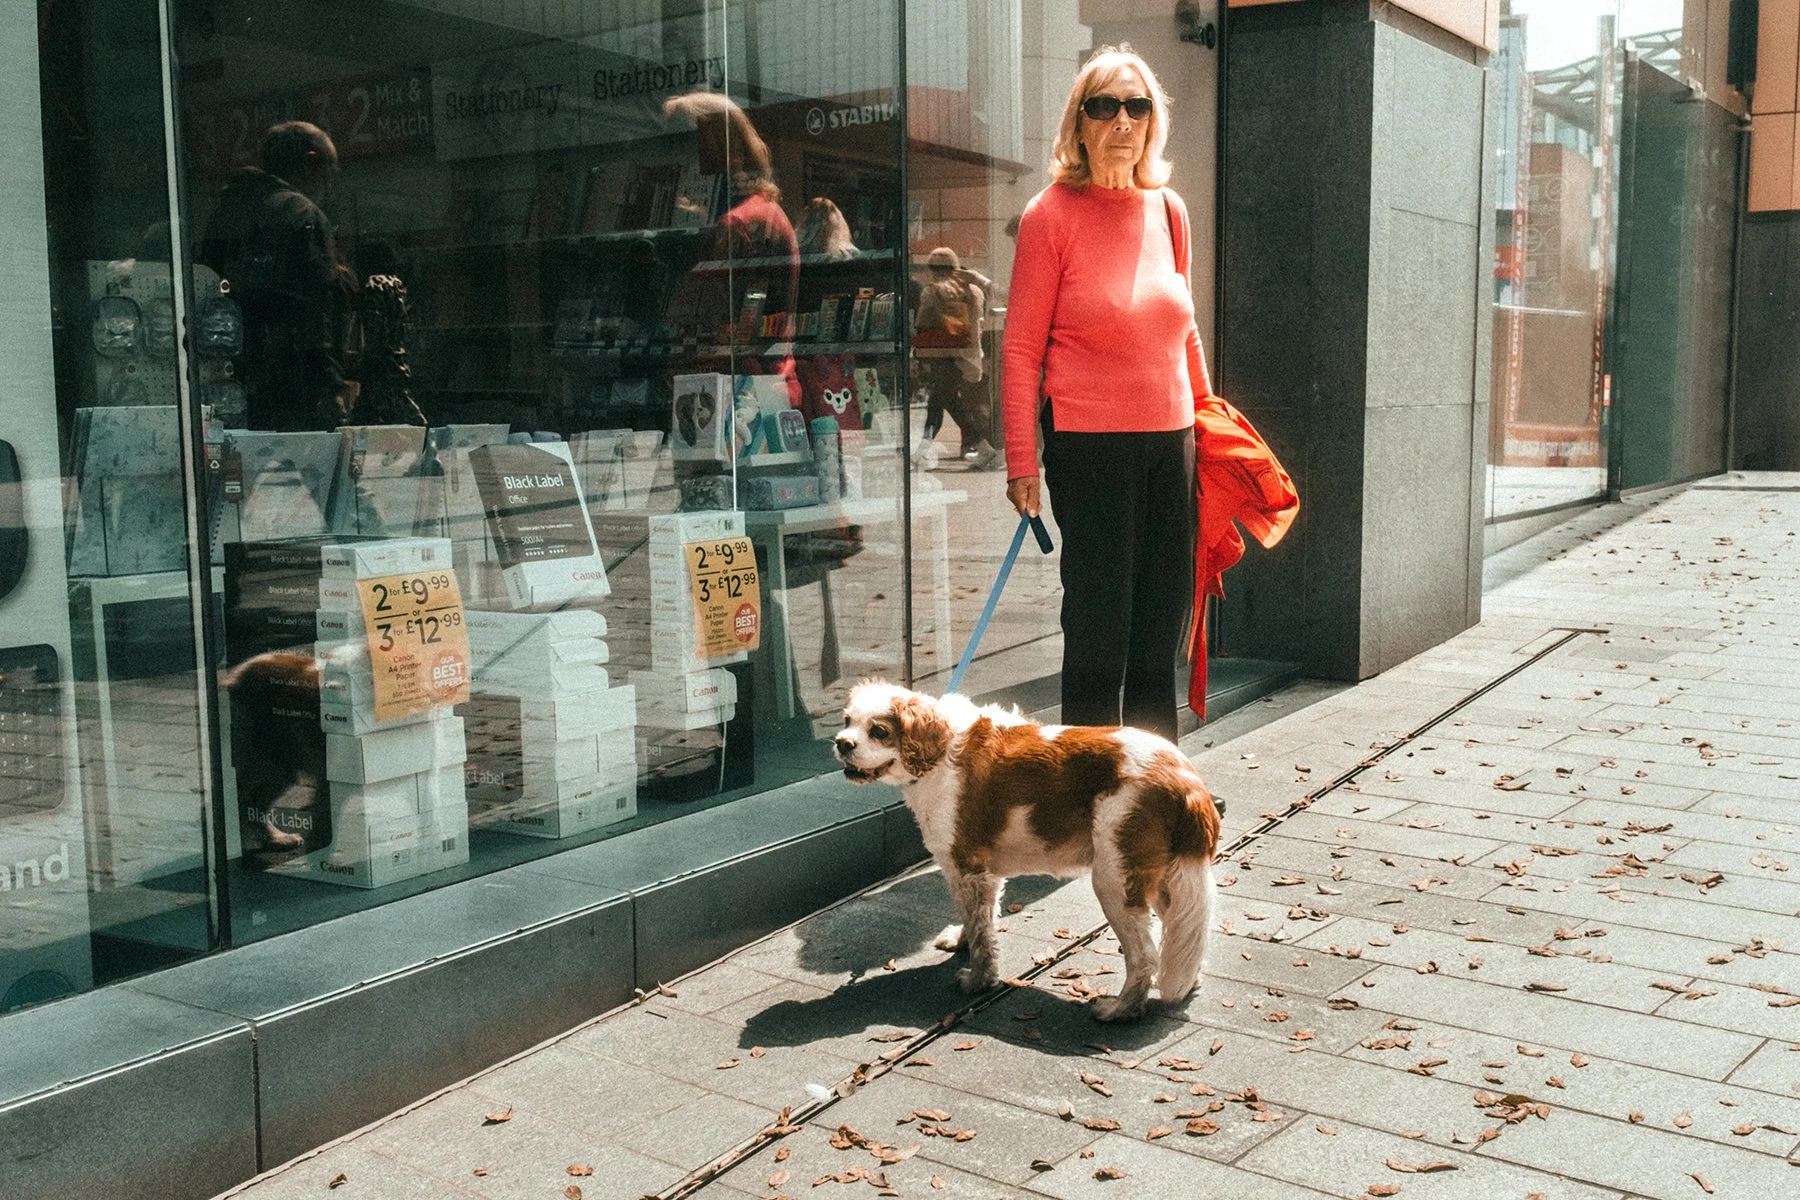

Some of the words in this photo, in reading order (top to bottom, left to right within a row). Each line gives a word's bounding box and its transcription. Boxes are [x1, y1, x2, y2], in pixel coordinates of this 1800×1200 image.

[593, 56, 726, 101] Stationery
[503, 475, 535, 490] Black
[535, 473, 564, 488] Label
[509, 494, 528, 504] Office
[326, 558, 350, 566] Canon
[695, 546, 709, 569] 2
[572, 570, 602, 582] Canon
[698, 579, 710, 602] 3
[372, 584, 392, 612] 2
[389, 587, 400, 597] for
[412, 609, 421, 617] or
[320, 620, 344, 628] Canon
[736, 615, 756, 628] BEST
[376, 623, 394, 652] 3
[393, 627, 404, 636] for
[393, 654, 415, 664] Canon
[388, 665, 398, 673] A4
[433, 662, 464, 680] BEST
[693, 685, 719, 698] Canon
[324, 713, 348, 722] Canon
[473, 770, 505, 785] Label
[281, 811, 314, 831] Label
[319, 860, 355, 876] Canon
